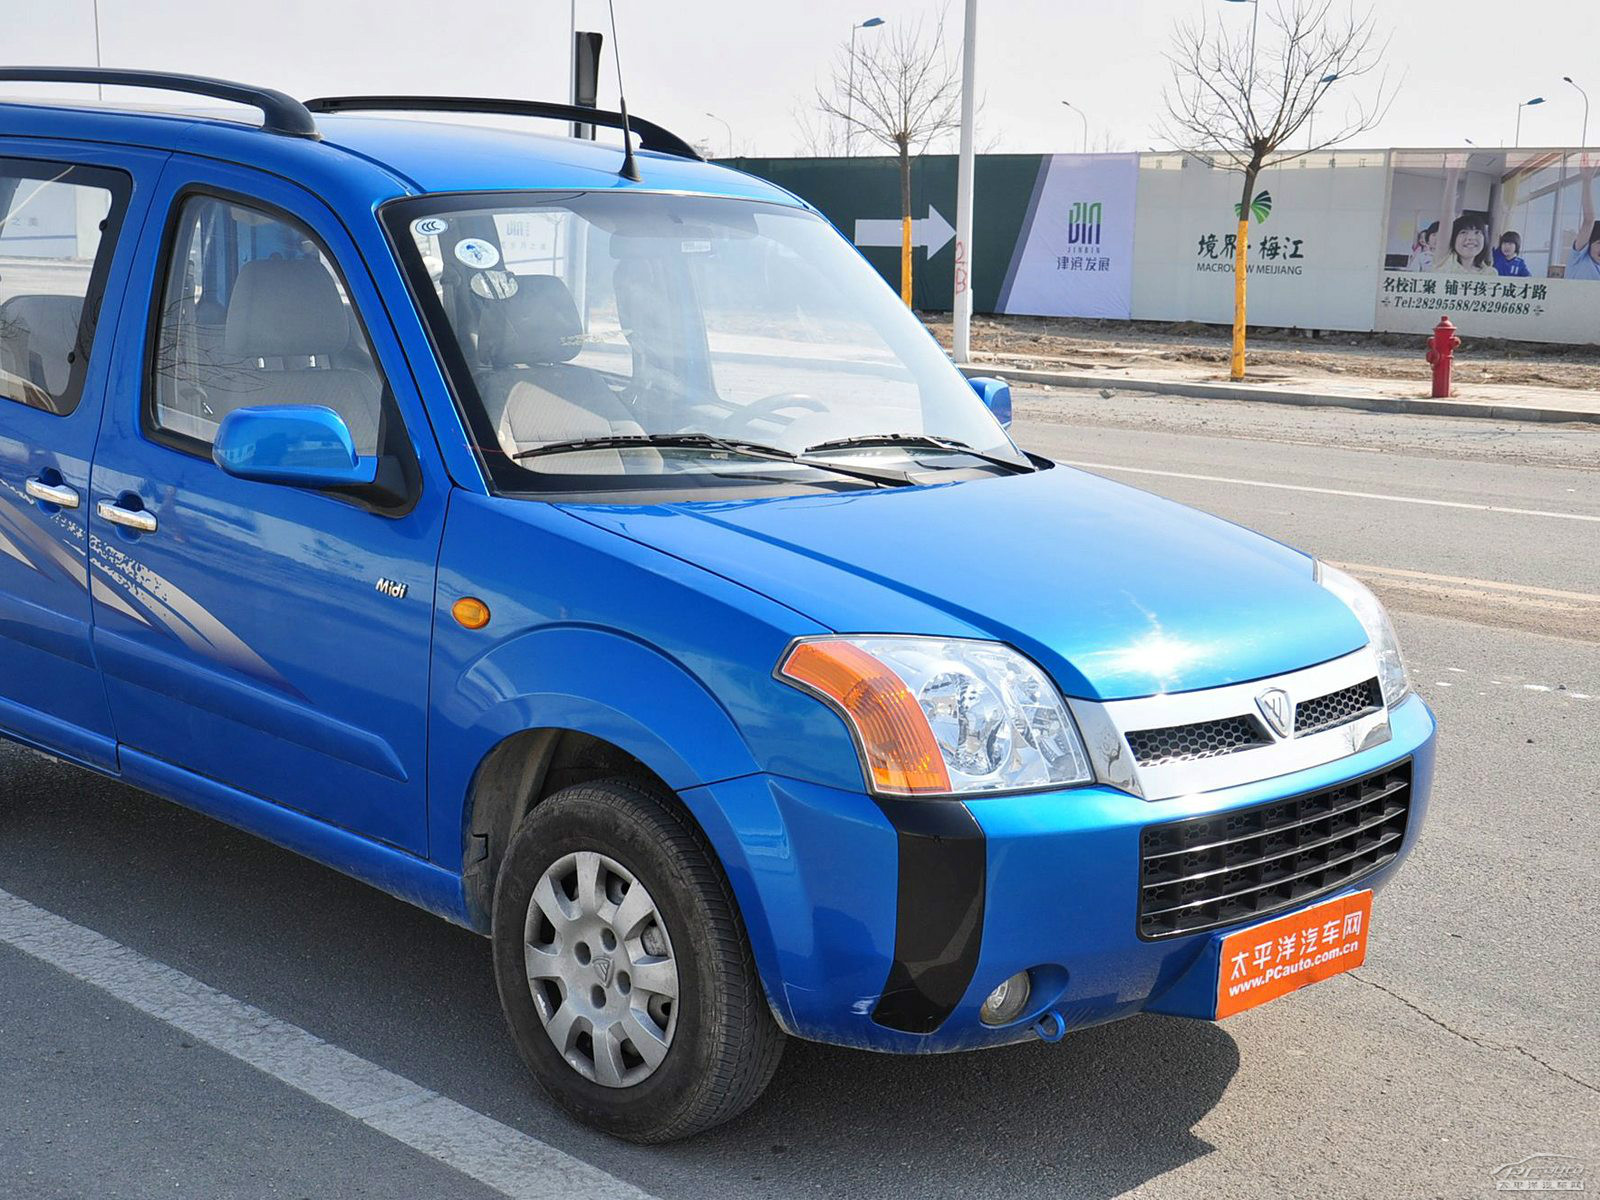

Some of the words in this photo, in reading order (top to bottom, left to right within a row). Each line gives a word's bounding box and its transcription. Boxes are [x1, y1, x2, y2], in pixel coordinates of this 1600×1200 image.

[1056, 256, 1110, 271] 津滨发展
[1256, 265, 1302, 275] MEIJIANG
[1383, 276, 1436, 295] 名校汇聚
[1444, 280, 1547, 300] 铺平孩子成才路
[1394, 296, 1530, 315] Tel:28295588/28296688
[375, 577, 408, 599] Midi
[1230, 910, 1362, 980] 太平洋汽车网
[1228, 940, 1358, 997] www.PCauto.com.cn
